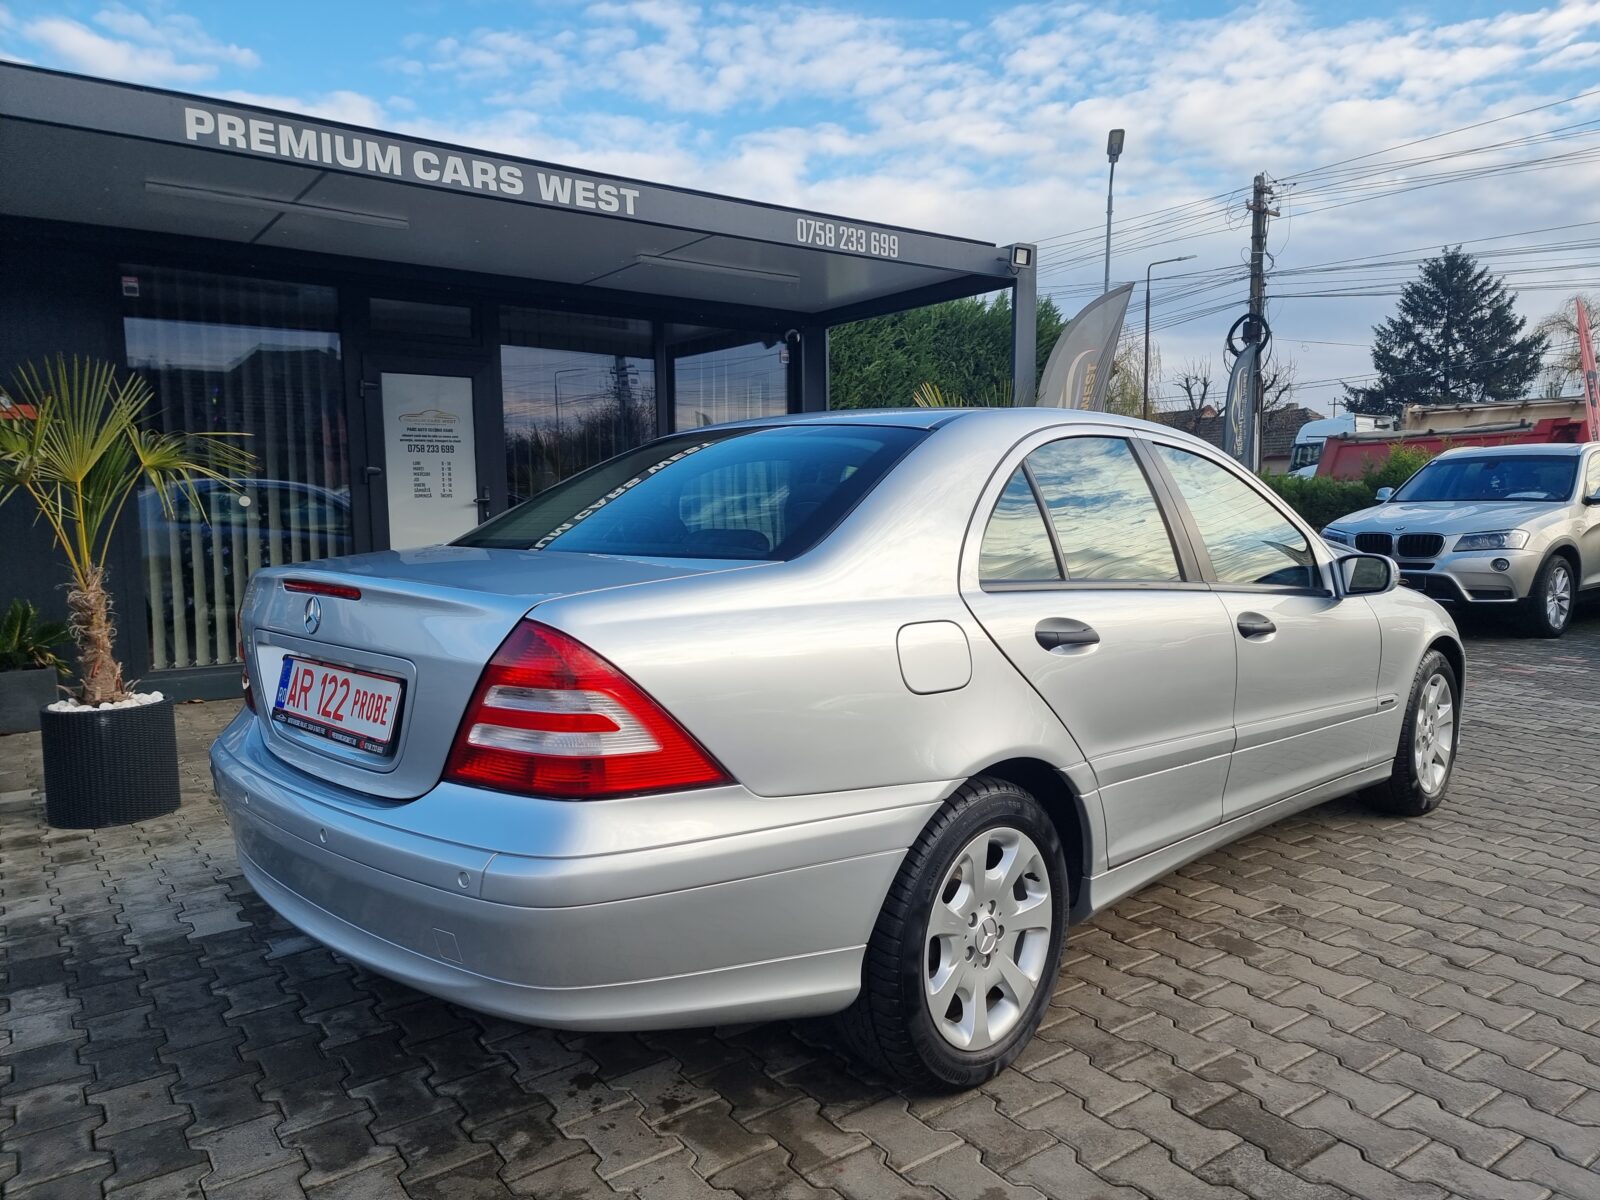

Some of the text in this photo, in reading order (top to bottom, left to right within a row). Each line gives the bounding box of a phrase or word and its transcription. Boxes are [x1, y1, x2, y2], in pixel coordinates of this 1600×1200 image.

[184, 107, 640, 216] PREMIUM CARS WEST
[797, 218, 899, 258] 0758 233 699
[408, 444, 455, 454] 0758 233 699
[278, 686, 288, 702] RO
[287, 666, 393, 726] AR 122 PROBE
